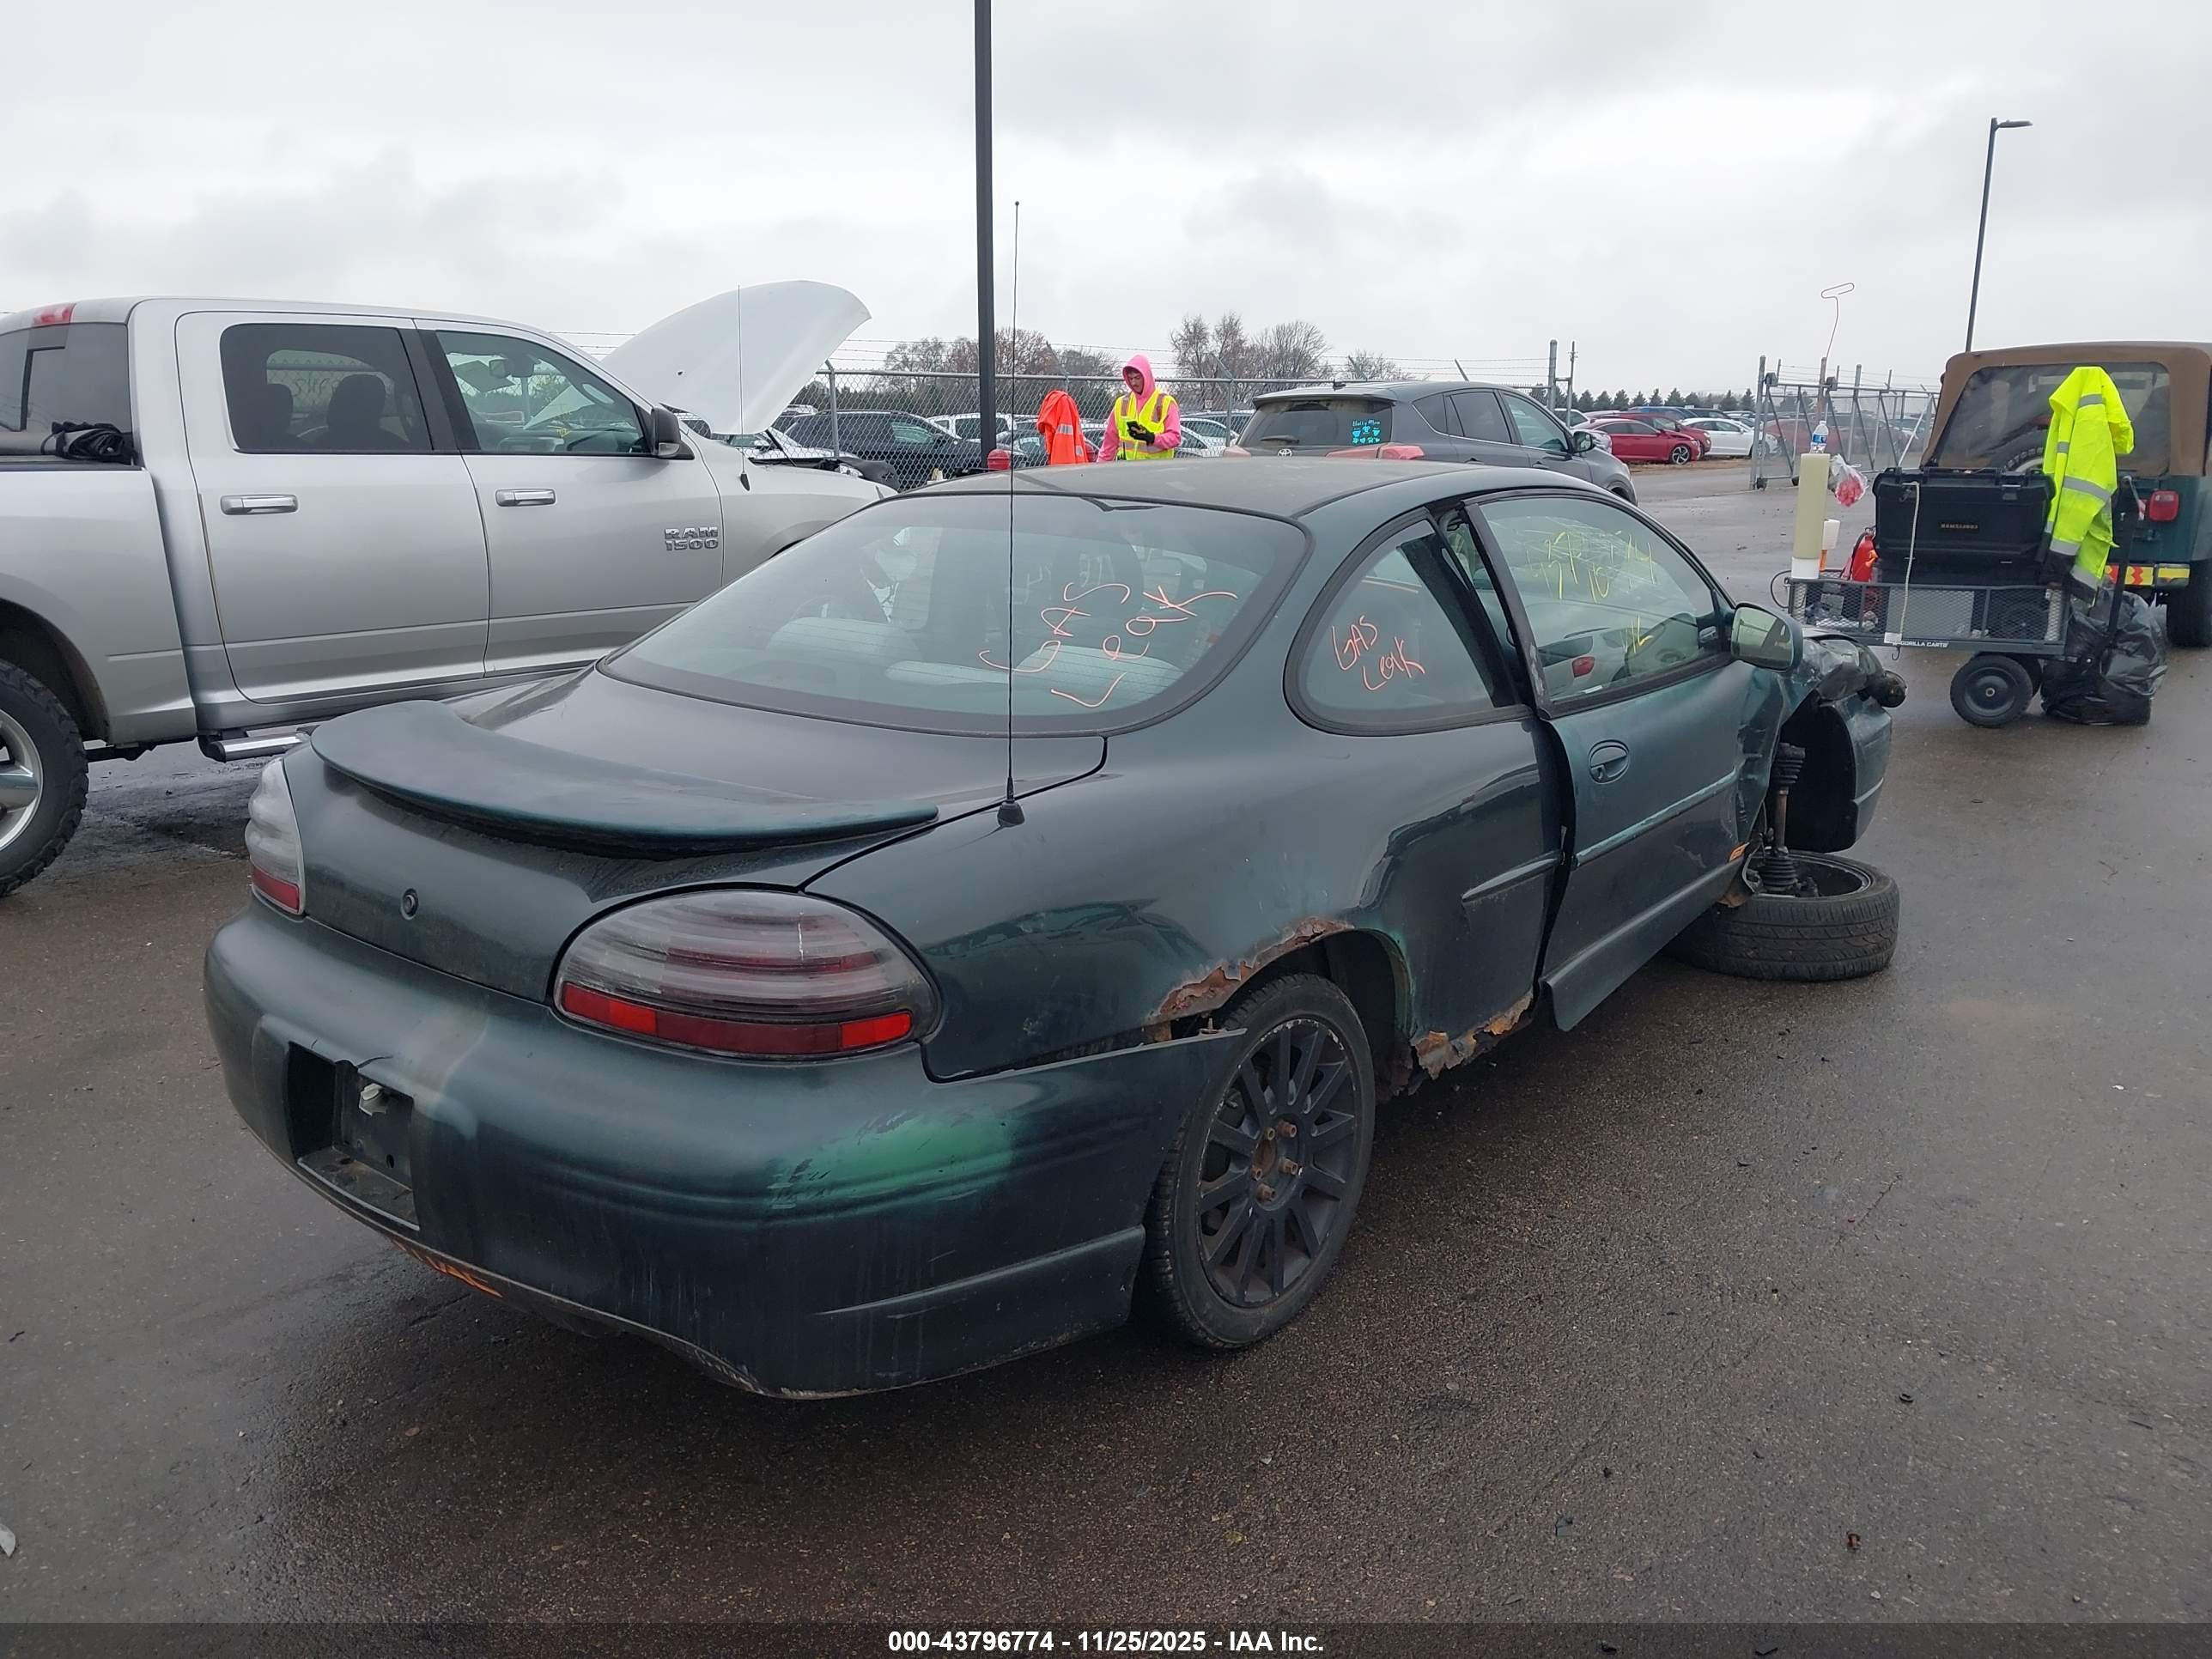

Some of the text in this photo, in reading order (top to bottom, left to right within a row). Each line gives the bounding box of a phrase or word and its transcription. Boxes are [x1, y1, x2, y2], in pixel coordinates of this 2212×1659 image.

[665, 526, 719, 539] RAM
[665, 538, 719, 550] 1500
[1332, 614, 1378, 671] GAS
